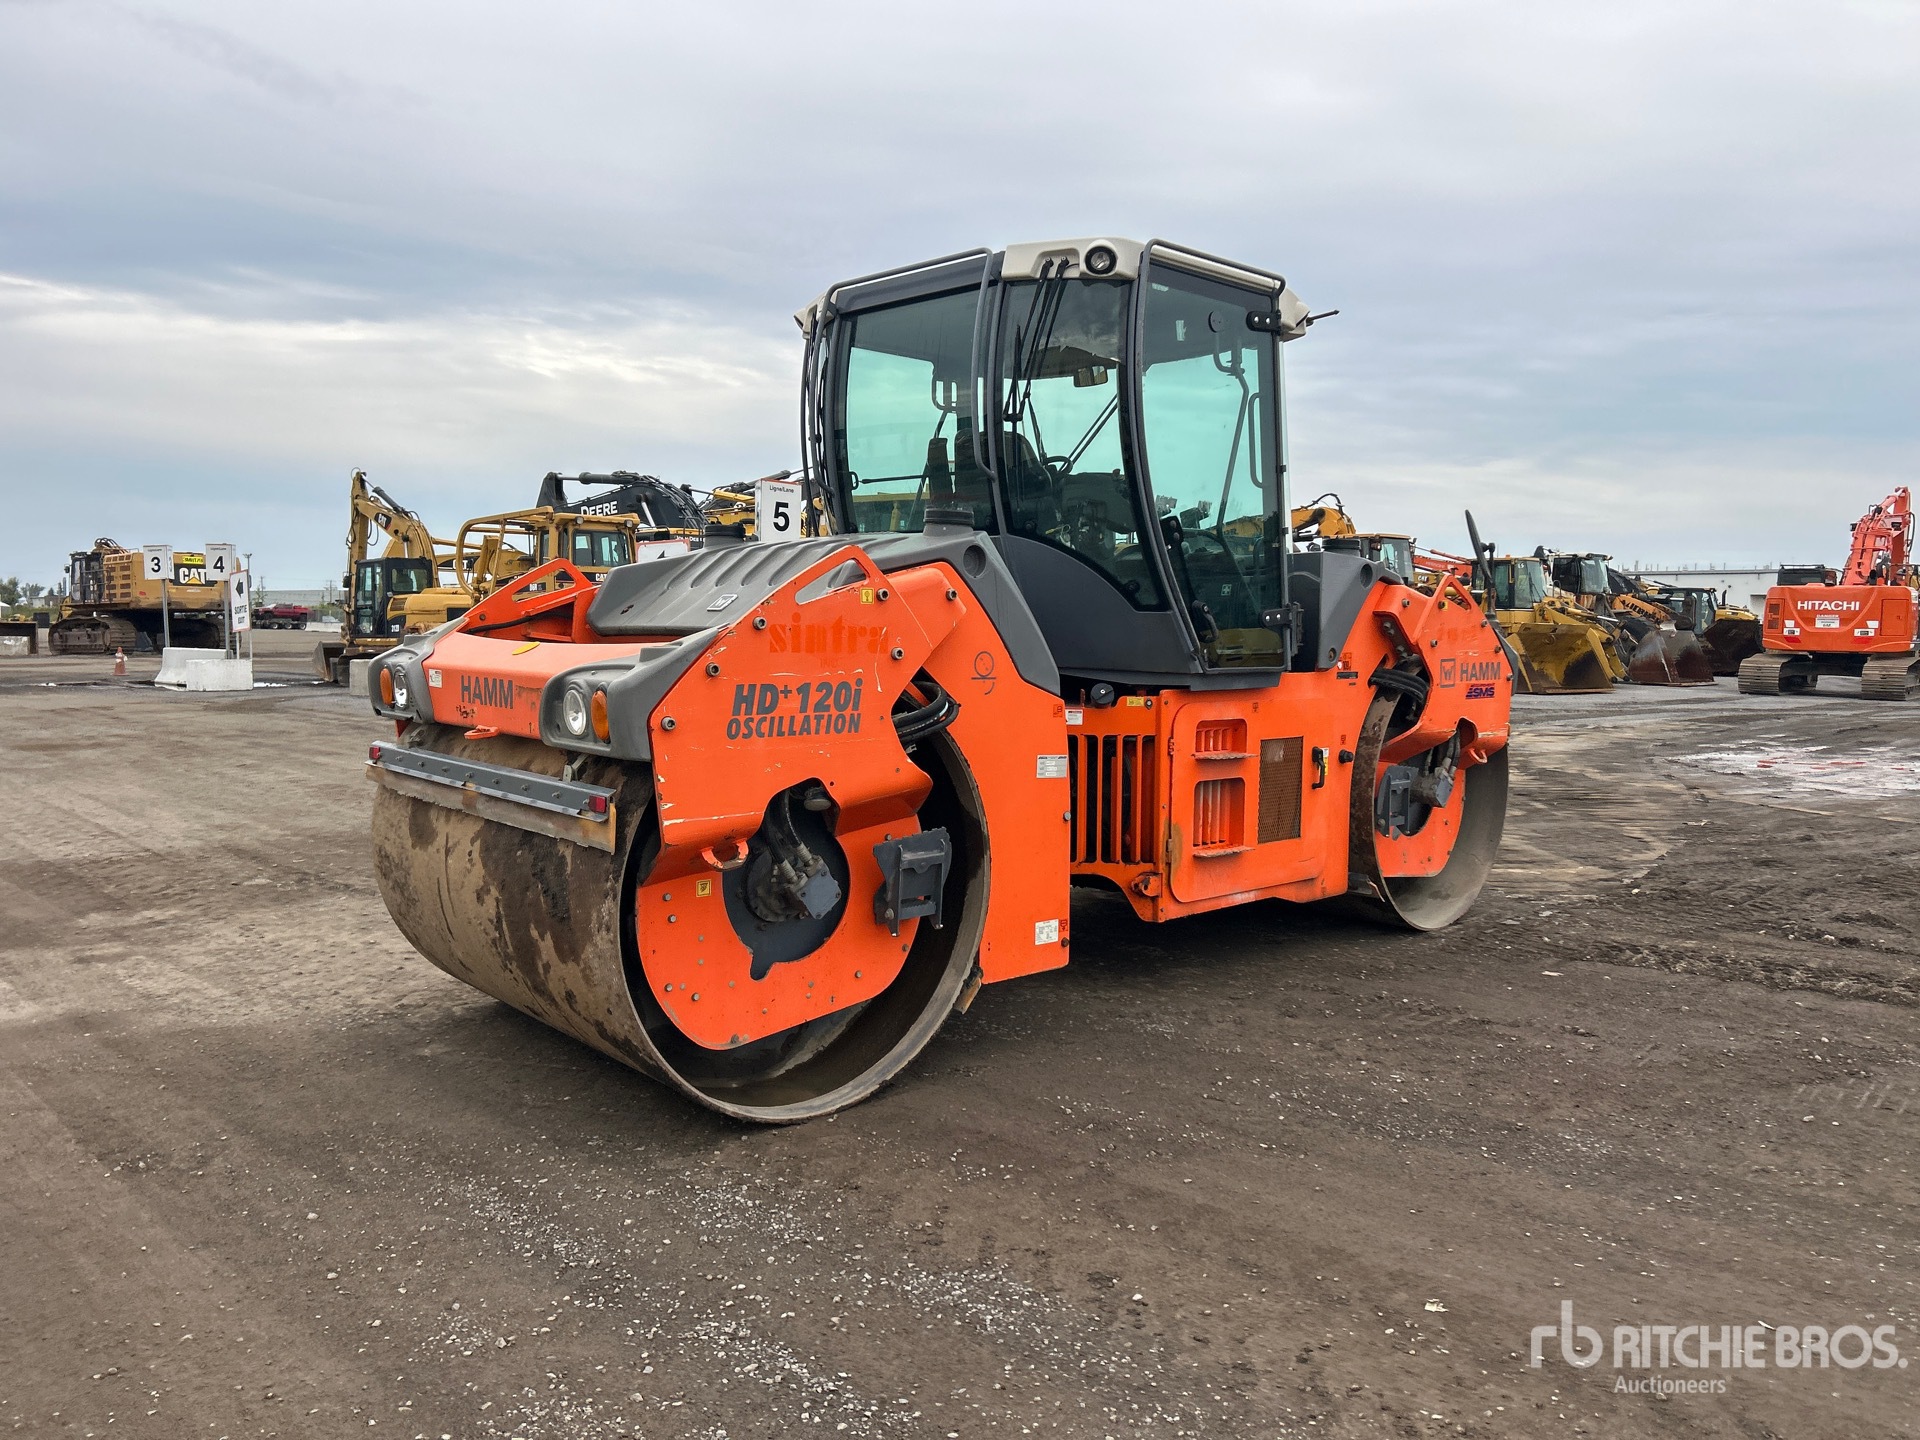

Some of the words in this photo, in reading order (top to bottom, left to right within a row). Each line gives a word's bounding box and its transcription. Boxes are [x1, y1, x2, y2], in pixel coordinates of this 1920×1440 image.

[580, 500, 618, 516] DEERE
[772, 501, 790, 532] 5
[150, 556, 161, 573] 3
[213, 555, 225, 573] 4
[179, 567, 207, 585] CAT
[596, 573, 608, 582] CAT
[1797, 600, 1860, 611] HITACHI
[1460, 662, 1501, 682] HAMM
[461, 674, 514, 710] HAMM
[726, 713, 862, 740] OSCILLATION
